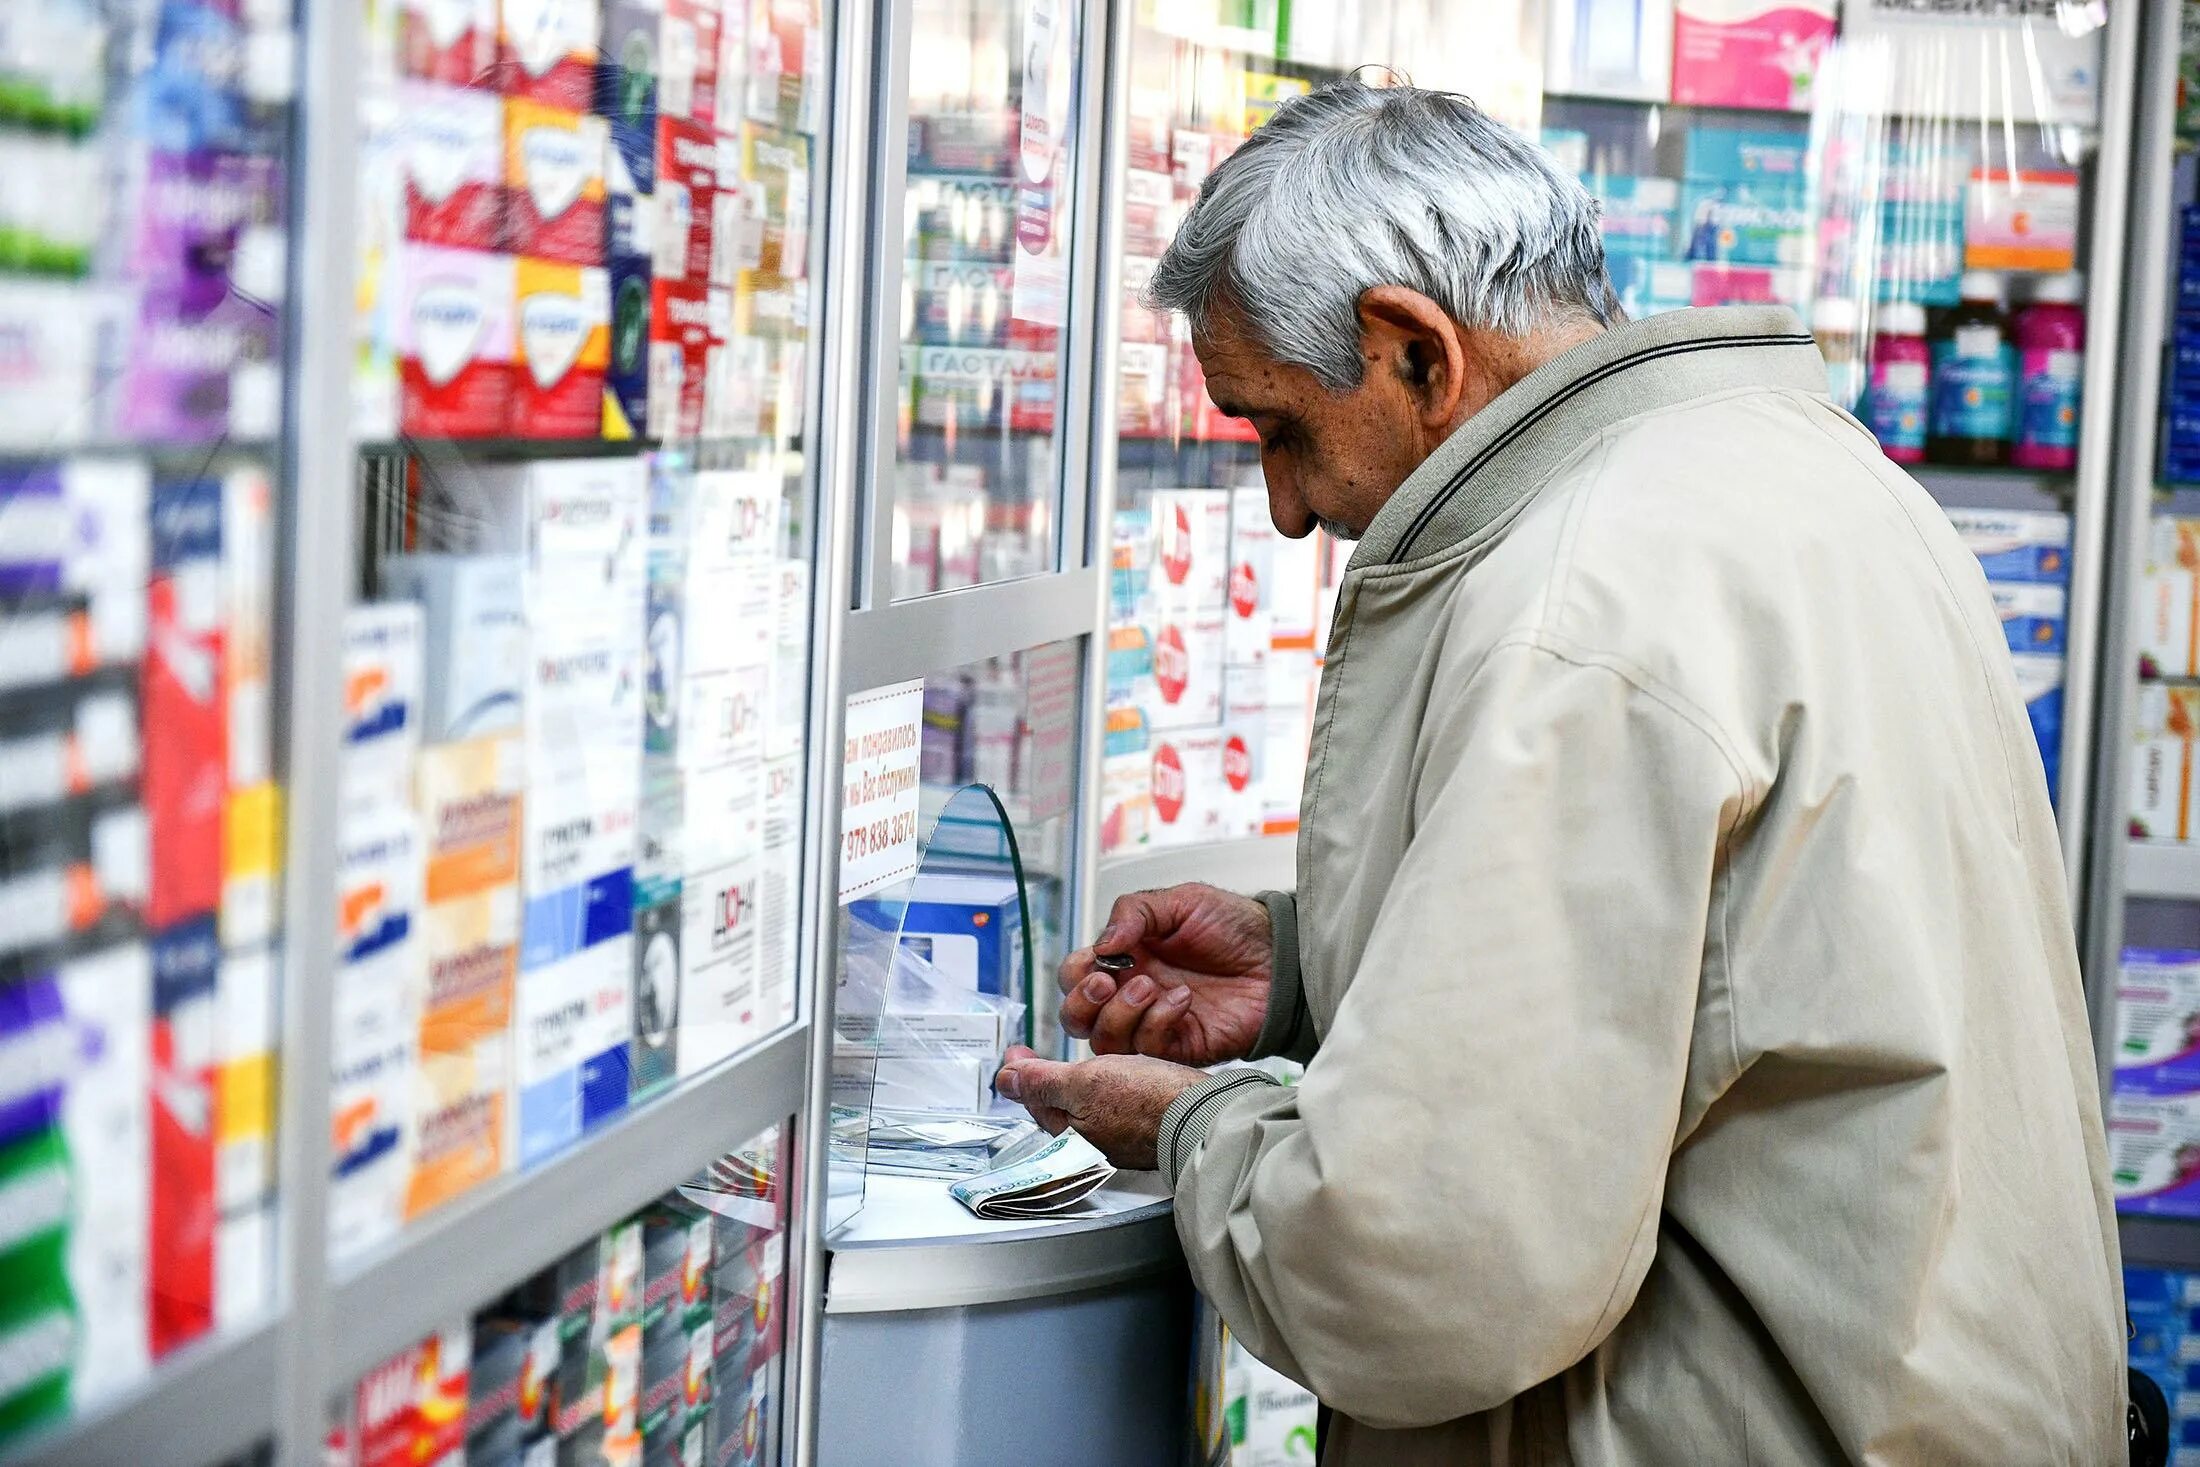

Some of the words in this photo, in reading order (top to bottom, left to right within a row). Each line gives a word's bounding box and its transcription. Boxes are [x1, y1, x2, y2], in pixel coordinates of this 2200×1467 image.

[862, 722, 917, 764] понравилось
[863, 770, 876, 804] Вас
[847, 826, 867, 862] 978
[870, 818, 889, 855] 838
[891, 809, 916, 847] 3674
